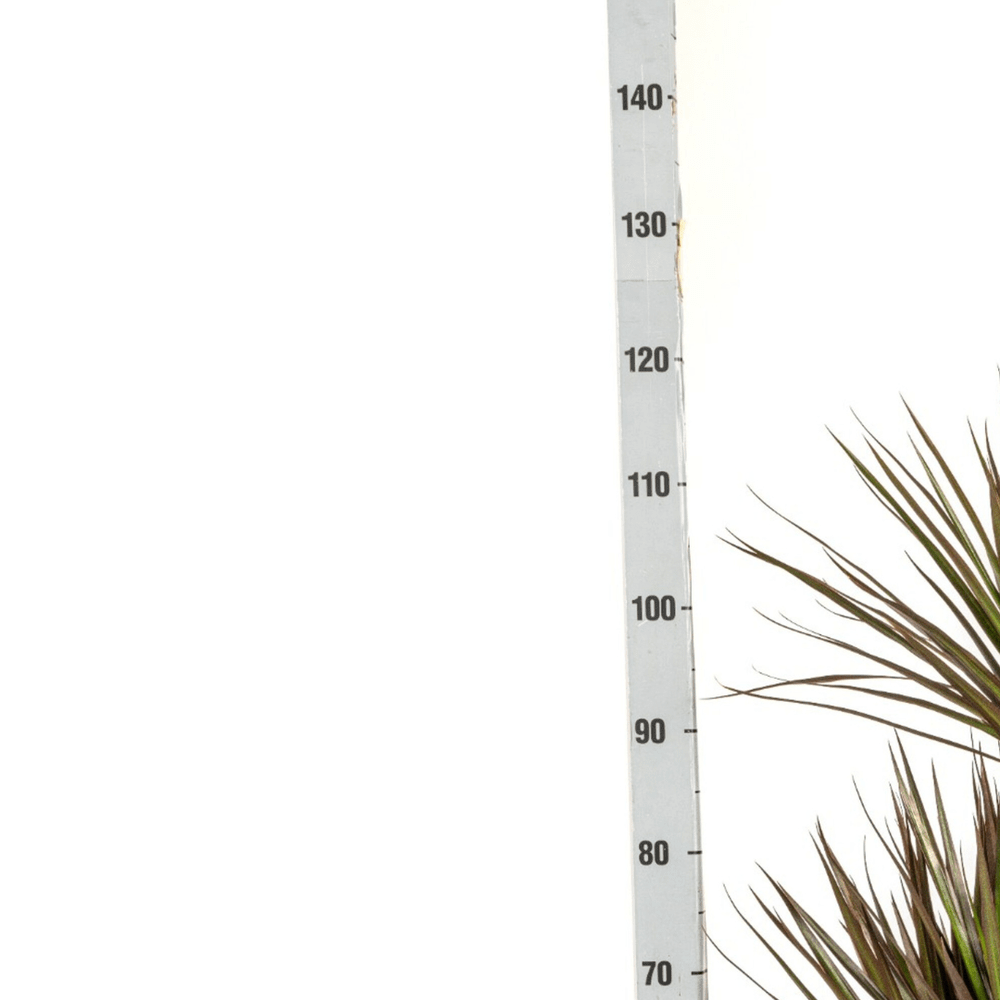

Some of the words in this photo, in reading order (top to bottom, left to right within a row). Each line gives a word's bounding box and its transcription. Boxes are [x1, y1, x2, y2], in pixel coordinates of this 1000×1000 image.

[617, 83, 663, 111] 140
[621, 211, 666, 238] 130
[624, 346, 669, 372] 120
[628, 471, 670, 497] 110
[632, 595, 676, 621] 100
[635, 718, 665, 744] 90
[638, 840, 669, 866] 80
[642, 960, 672, 986] 70
